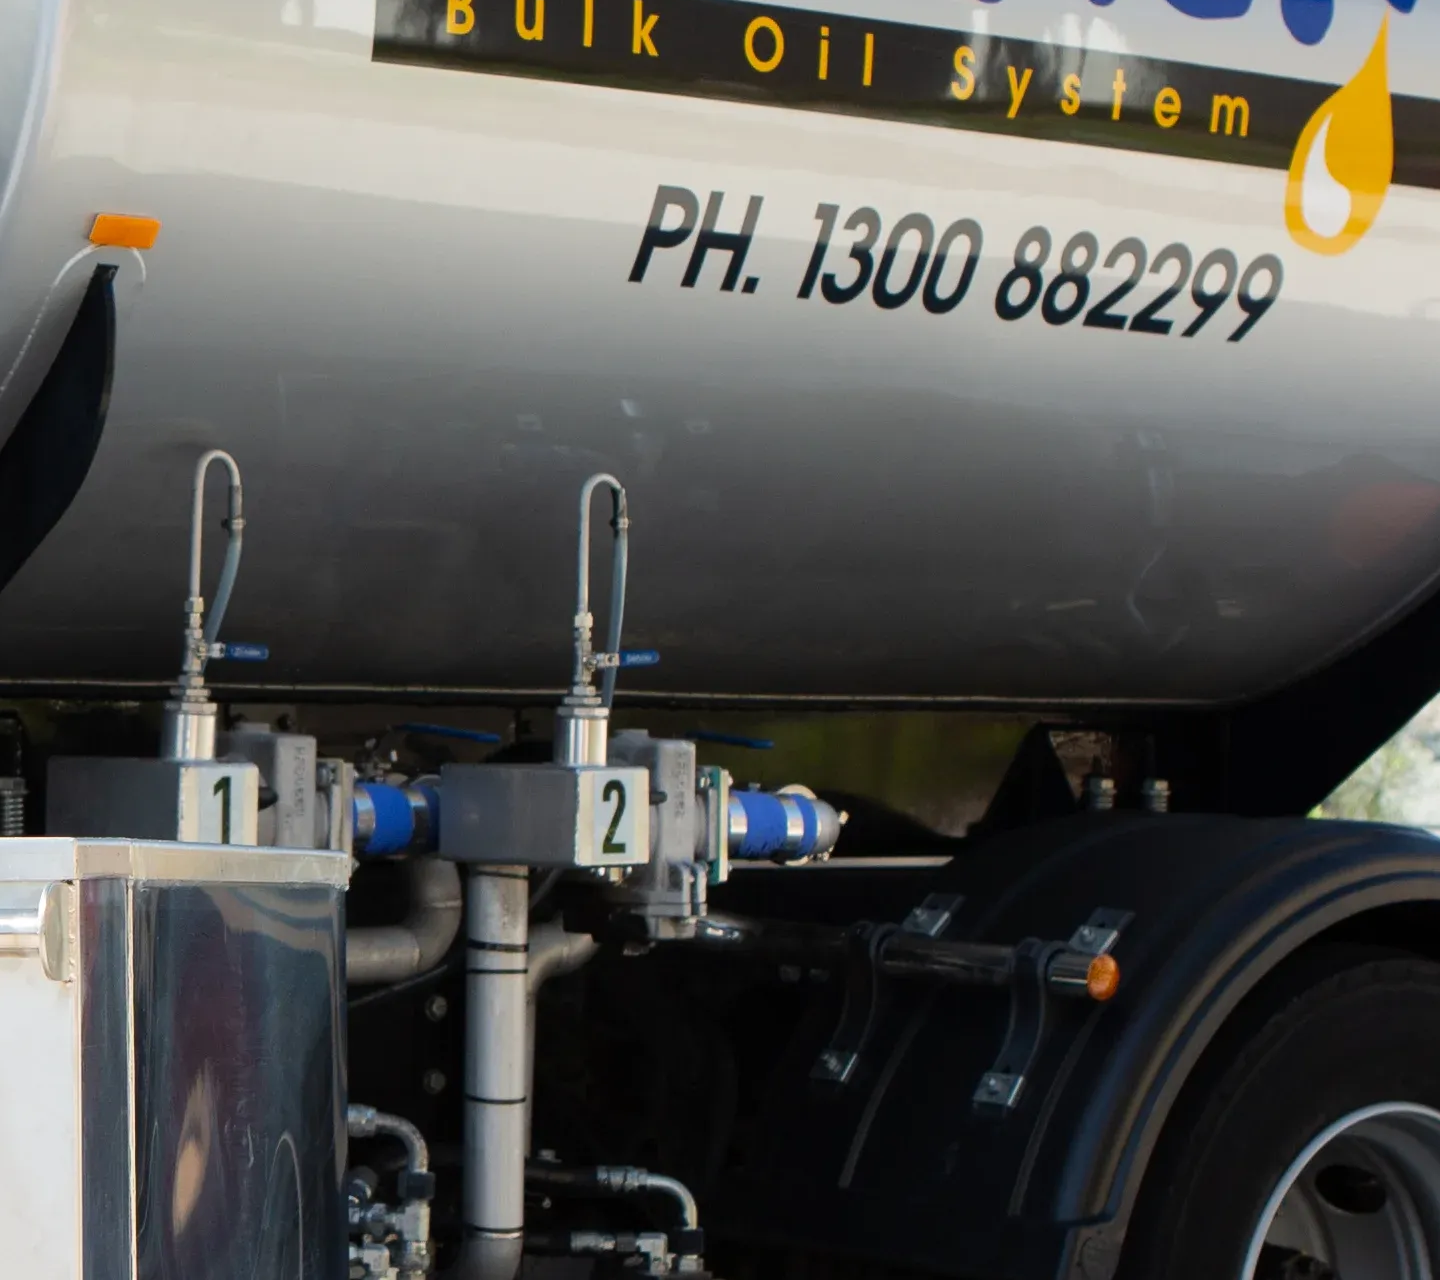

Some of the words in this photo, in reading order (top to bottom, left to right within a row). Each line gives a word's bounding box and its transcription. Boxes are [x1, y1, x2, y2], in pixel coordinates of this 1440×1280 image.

[744, 14, 875, 88] Oil
[950, 44, 1252, 138] System
[627, 183, 765, 294] PH.
[796, 202, 984, 315] 1300
[994, 226, 1284, 343] 882299
[212, 775, 234, 845] 1
[600, 778, 627, 855] 2
